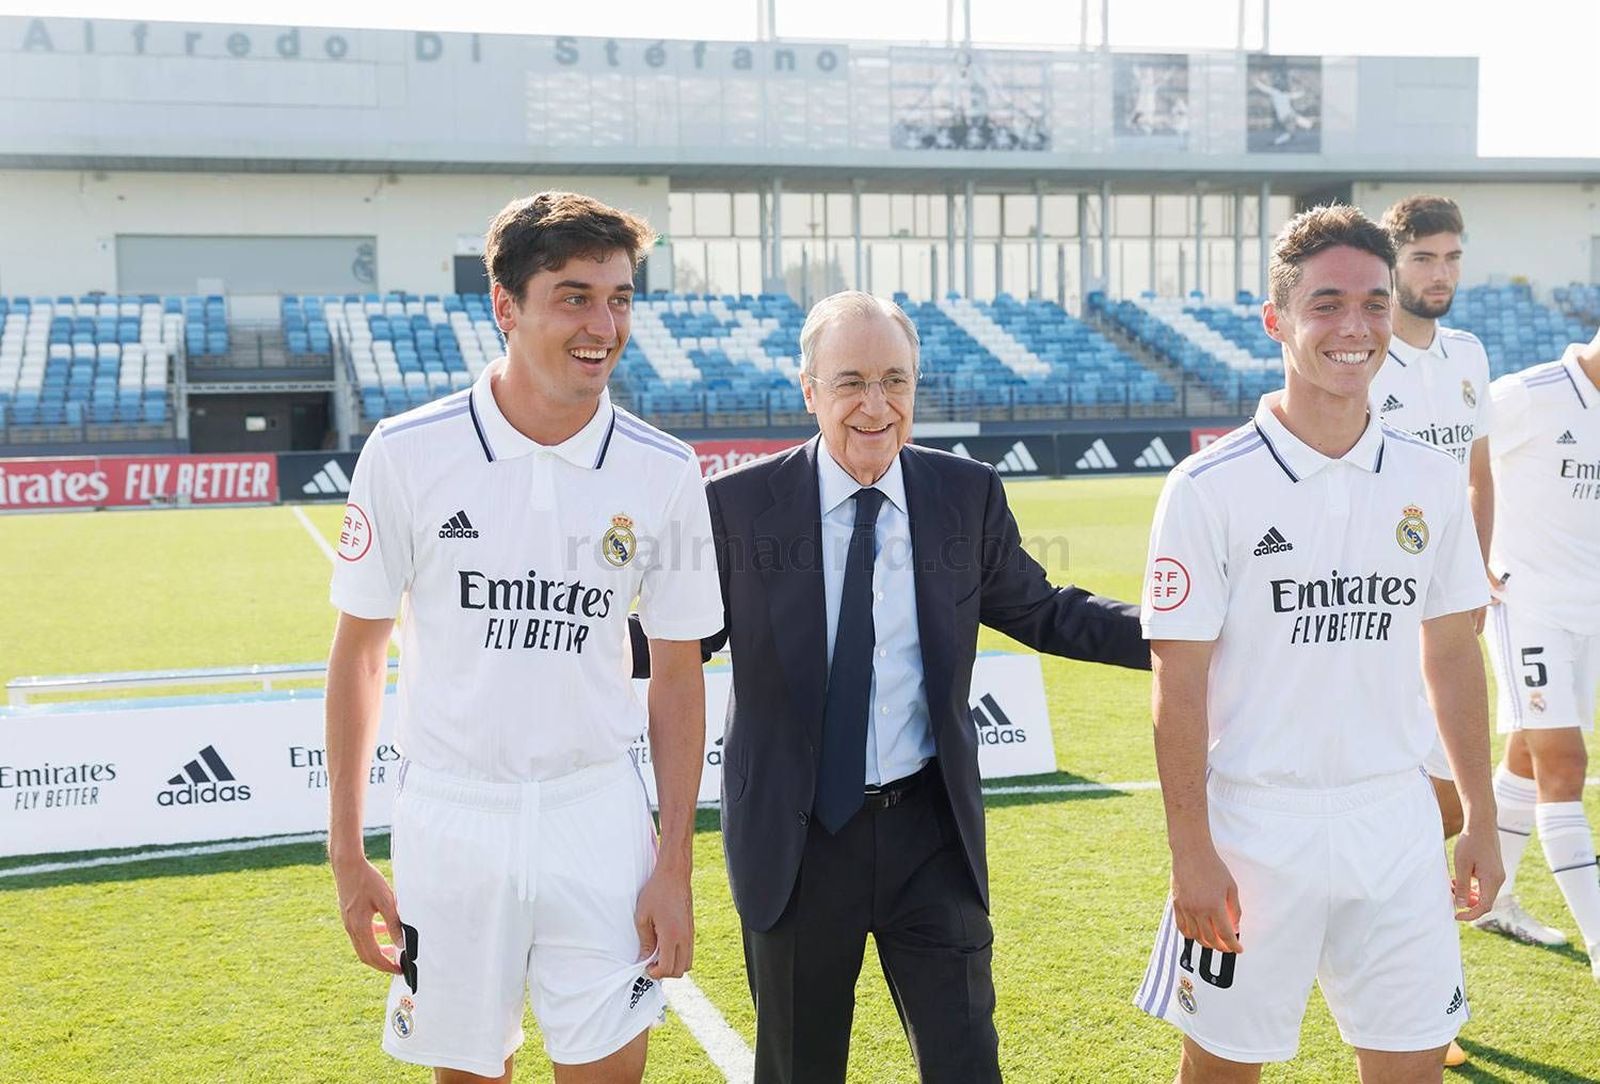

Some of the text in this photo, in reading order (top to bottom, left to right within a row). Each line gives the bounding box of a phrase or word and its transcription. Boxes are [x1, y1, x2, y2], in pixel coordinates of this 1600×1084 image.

[22, 17, 348, 58] Alfredo
[414, 31, 481, 62] Di
[125, 464, 170, 500] FLY
[176, 462, 270, 499] BETTER
[438, 528, 479, 539] adidas
[1253, 542, 1294, 556] adidas
[458, 570, 614, 618] Emirates
[1270, 569, 1417, 613] Emirates
[485, 618, 519, 650] FLY
[1521, 646, 1548, 688] 5
[979, 726, 1027, 745] idas
[0, 763, 117, 788] Emirates
[15, 786, 99, 811] FLY BETTER
[157, 782, 251, 806] adidas
